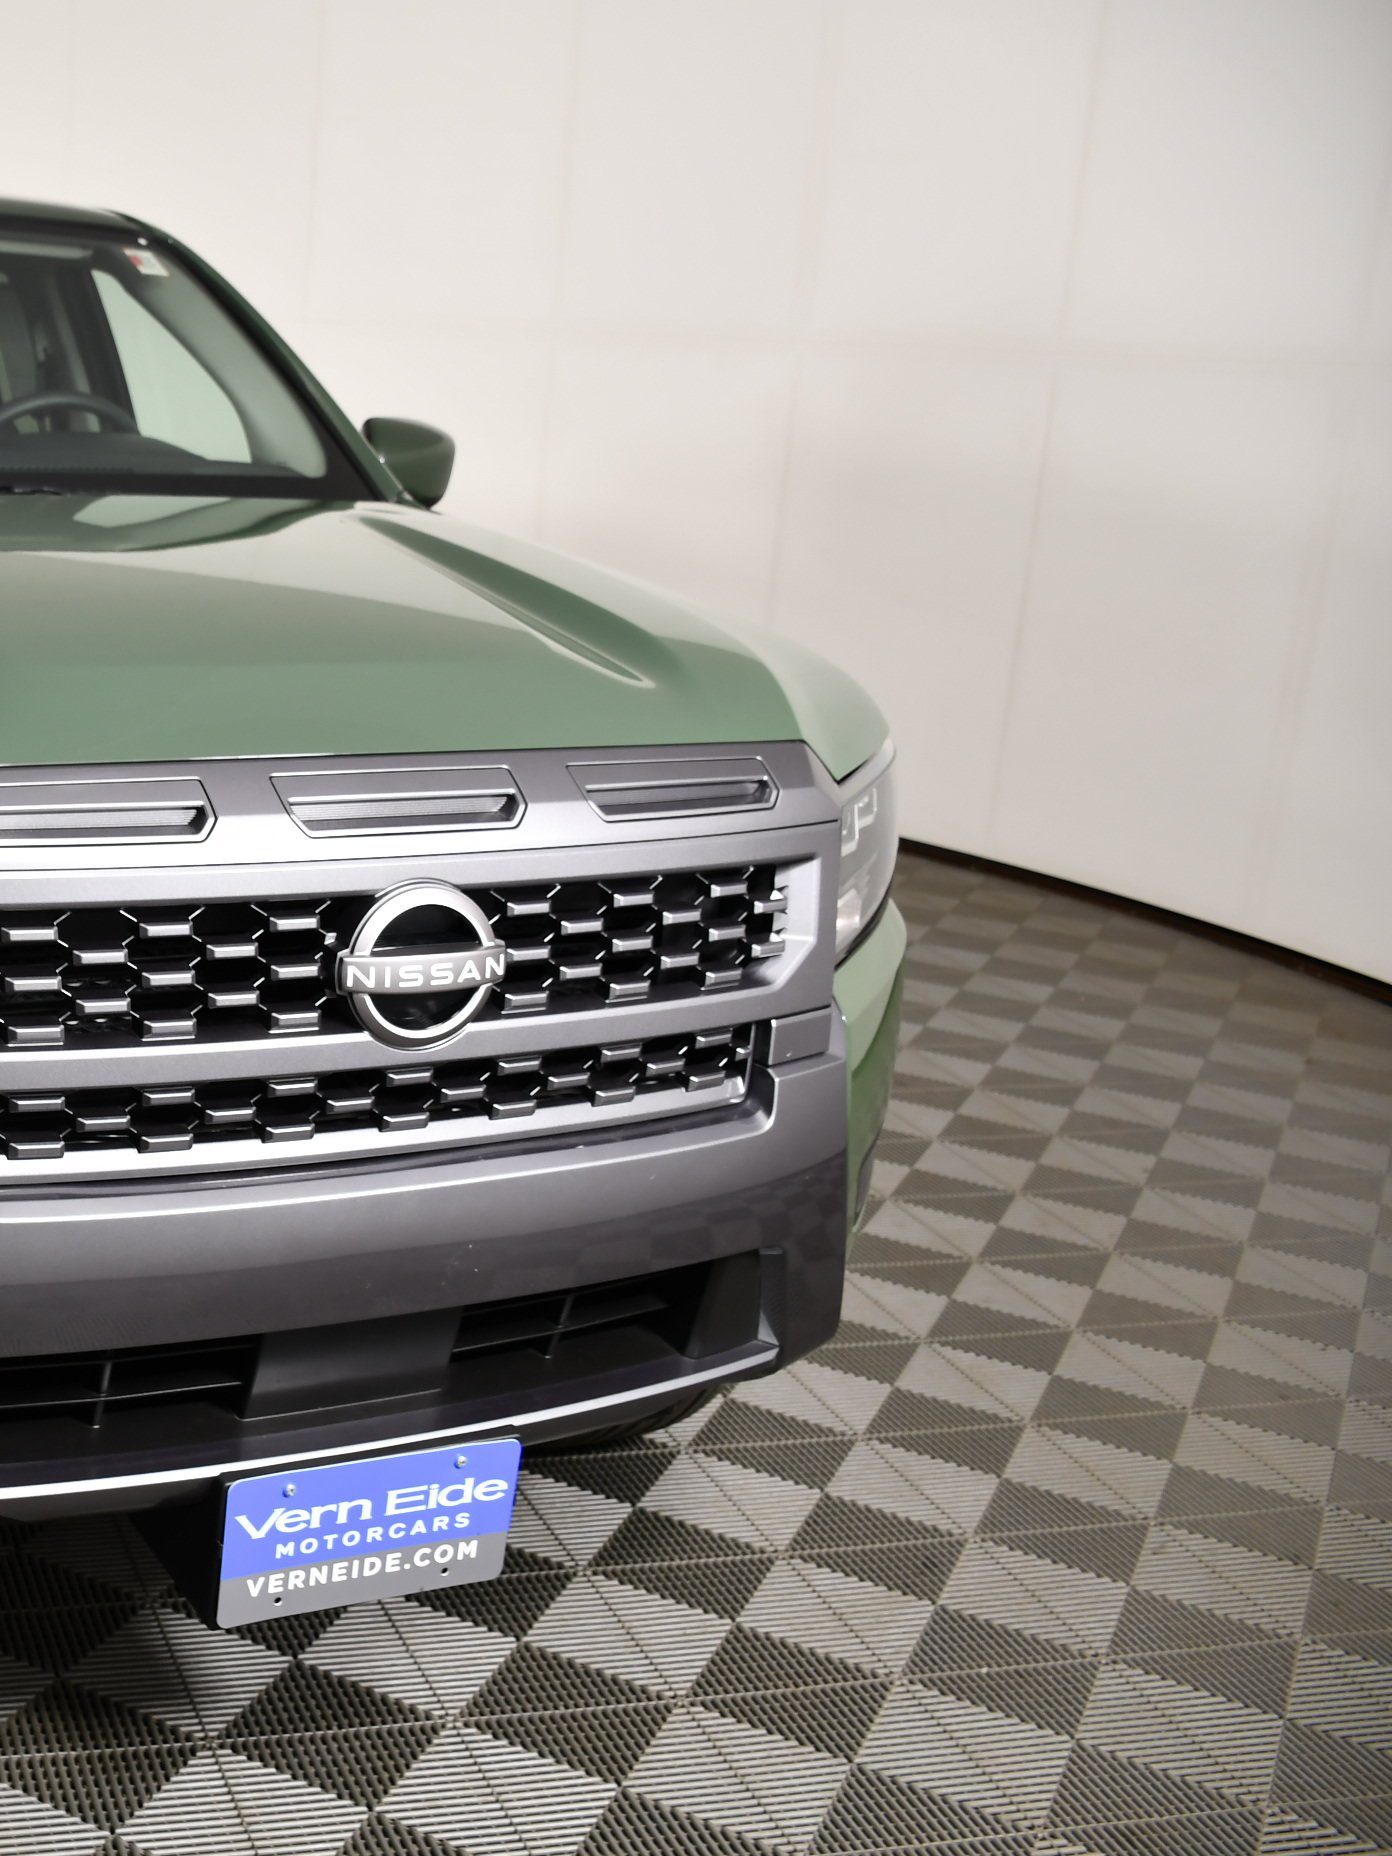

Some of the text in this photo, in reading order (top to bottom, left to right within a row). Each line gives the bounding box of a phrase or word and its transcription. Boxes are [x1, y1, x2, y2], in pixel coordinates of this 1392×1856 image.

[346, 953, 505, 989] NISSAN
[234, 1477, 509, 1540] Vern Eide
[274, 1512, 471, 1559] MOTORCARS
[246, 1539, 479, 1598] VERNEIDE.COM
